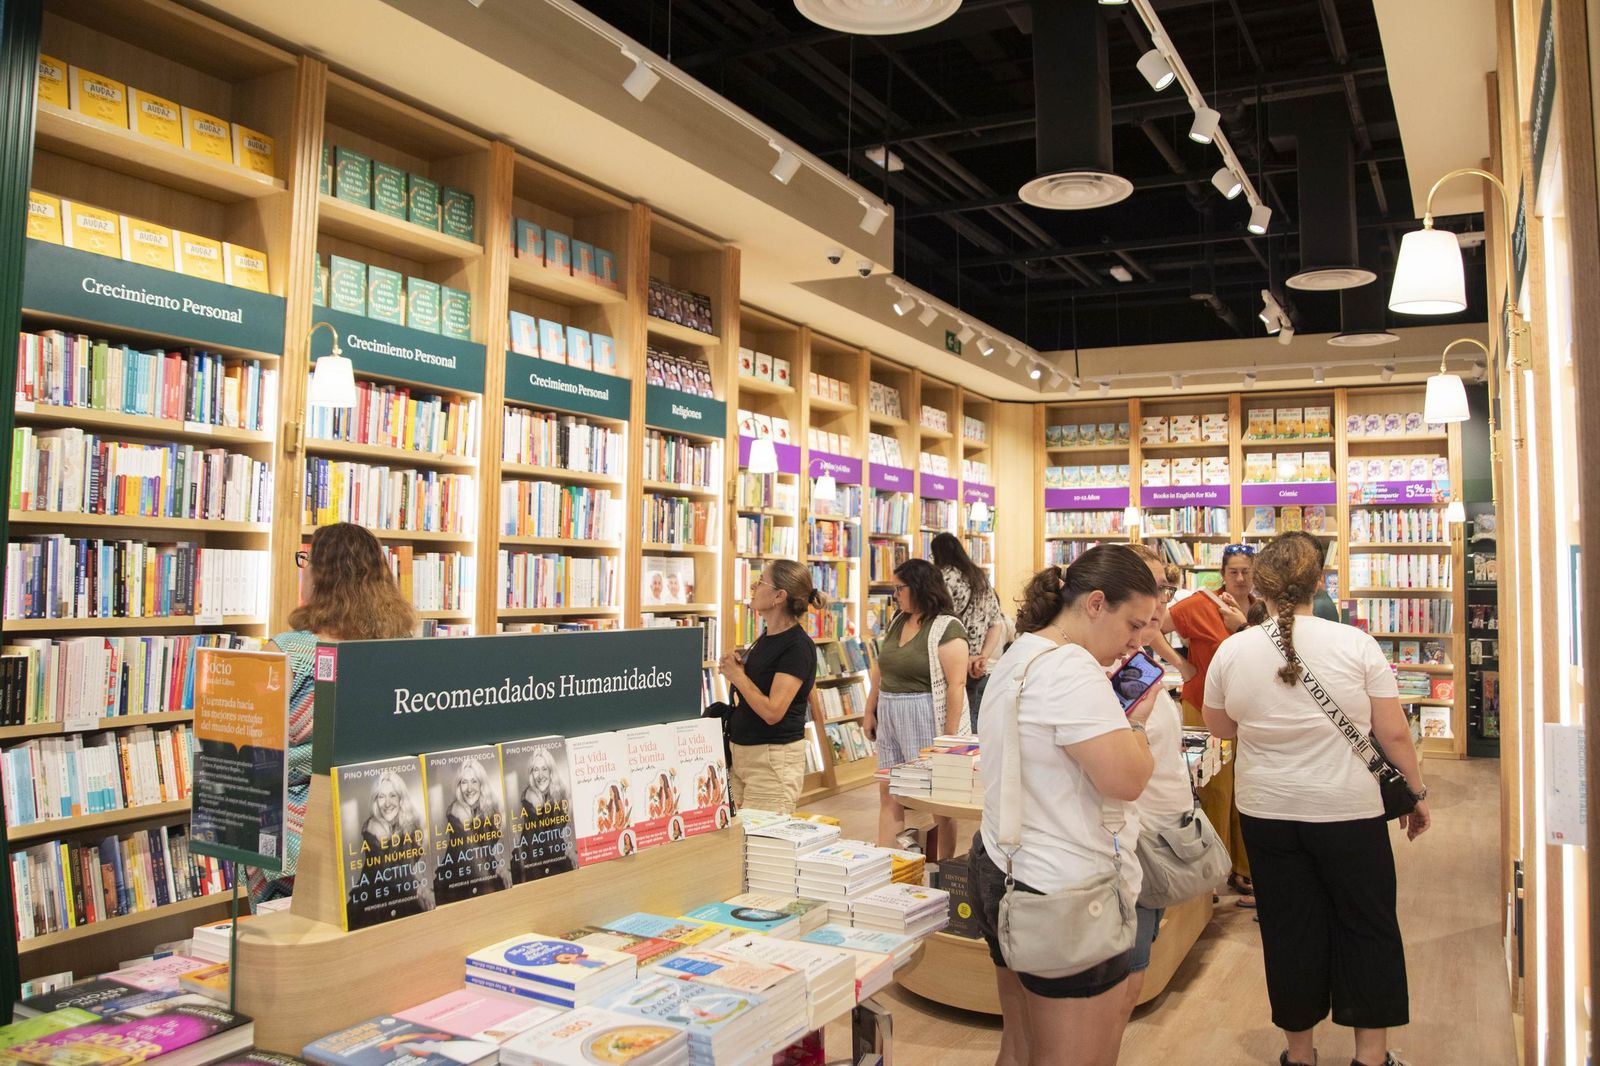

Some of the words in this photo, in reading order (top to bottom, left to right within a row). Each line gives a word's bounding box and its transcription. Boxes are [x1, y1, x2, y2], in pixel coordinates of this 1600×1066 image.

[89, 83, 116, 99] AUDAZ
[146, 101, 171, 118] AUDAZ
[197, 121, 221, 135] AUDAZ
[246, 139, 268, 153] AUDAZ
[82, 216, 108, 231] AUDAZ
[139, 231, 163, 245] AUDAZ
[190, 244, 213, 257] AUDAZ
[239, 256, 259, 268] AUDAZ
[81, 277, 180, 310] Crecimiento
[182, 298, 243, 324] Personal
[347, 334, 413, 360] Crecimiento
[414, 351, 456, 370] Personal
[529, 373, 578, 392] Crecimiento
[578, 384, 609, 400] Personal
[671, 404, 702, 420] Religiones
[1176, 492, 1195, 500] English
[1406, 484, 1424, 498] 5%
[393, 676, 555, 715] Recomendados
[559, 666, 672, 698] Humanidades
[1303, 672, 1333, 708] LOLA
[1327, 708, 1339, 716] Y
[212, 722, 235, 734] mundo
[235, 724, 246, 735] del
[247, 725, 263, 738] libro
[522, 742, 562, 752] MONTESDEOCA
[677, 736, 687, 745] La
[688, 734, 705, 744] vida
[628, 744, 638, 754] La
[640, 742, 657, 753] vida
[678, 748, 686, 756] es
[689, 743, 713, 755] bonita
[431, 758, 446, 766] PINO
[449, 753, 495, 764] MONTESDEOCA
[575, 753, 585, 764] La
[587, 752, 607, 763] vida
[628, 756, 637, 764] es
[640, 751, 665, 763] bonita
[344, 772, 361, 780] PINO
[364, 764, 416, 777] MONTESDEOCA
[575, 768, 585, 776] es
[588, 762, 616, 775] bonita
[511, 808, 528, 820] LA
[536, 800, 569, 815] EDAD
[435, 822, 454, 836] LA
[464, 814, 503, 831] EDAD
[512, 824, 522, 833] ES
[525, 821, 536, 830] UN
[349, 839, 371, 855] LA
[381, 830, 424, 849] EDAD
[436, 841, 447, 850] ES
[451, 837, 463, 846] UN
[513, 836, 528, 848] LA
[532, 826, 571, 844] ACTITUD
[437, 852, 453, 866] LA
[458, 842, 504, 861] ACTITUD
[514, 851, 526, 861] LO
[533, 848, 544, 857] ES
[549, 842, 573, 853] TODO
[350, 859, 362, 870] ES
[367, 856, 381, 867] UN
[438, 870, 452, 880] LO
[459, 865, 471, 876] ES
[478, 859, 505, 871] TODO
[352, 874, 370, 888] LA
[375, 861, 427, 884] ACTITUD
[353, 891, 368, 903] LO
[375, 886, 390, 898] ES
[397, 879, 428, 893] TODO
